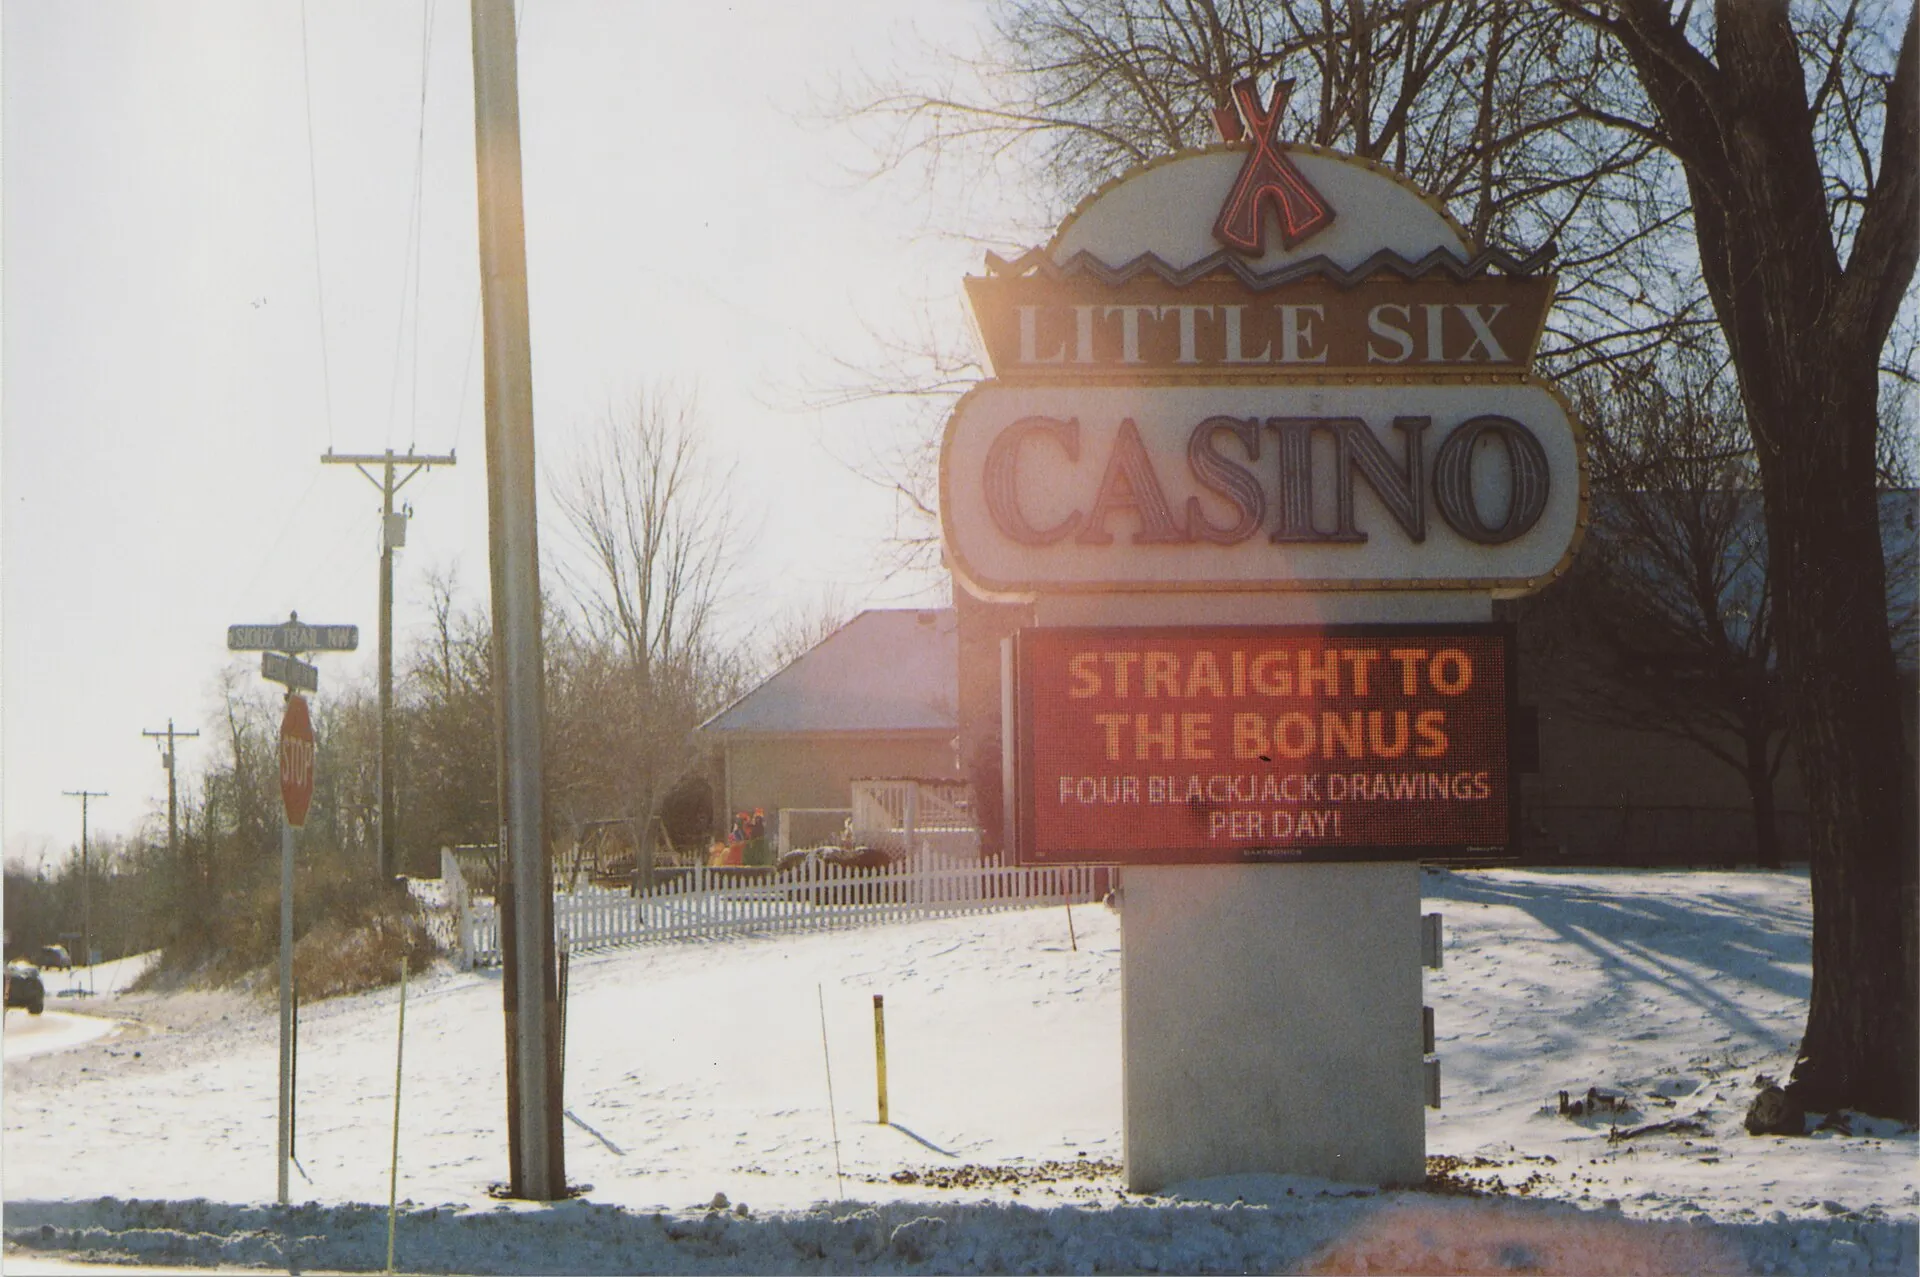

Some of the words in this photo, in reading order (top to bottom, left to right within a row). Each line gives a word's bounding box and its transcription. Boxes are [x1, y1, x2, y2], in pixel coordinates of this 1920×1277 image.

[1018, 302, 1329, 367] LITTLE
[1366, 301, 1513, 365] SIX
[982, 414, 1552, 546] CASINO
[235, 627, 276, 648] SIOUX
[283, 627, 321, 648] TRAIL
[327, 627, 350, 648] NW
[1067, 648, 1382, 700] STRAIGHT
[1387, 647, 1474, 697] TO
[281, 736, 313, 787] STOP
[1095, 711, 1212, 762] THE
[1233, 710, 1449, 760] BONUS
[1060, 775, 1140, 804] FOUR
[1148, 774, 1321, 804] BLACKJACK
[1328, 771, 1491, 801] DRAWINGS
[1209, 810, 1264, 839] PER
[1272, 810, 1341, 838] DAY!
